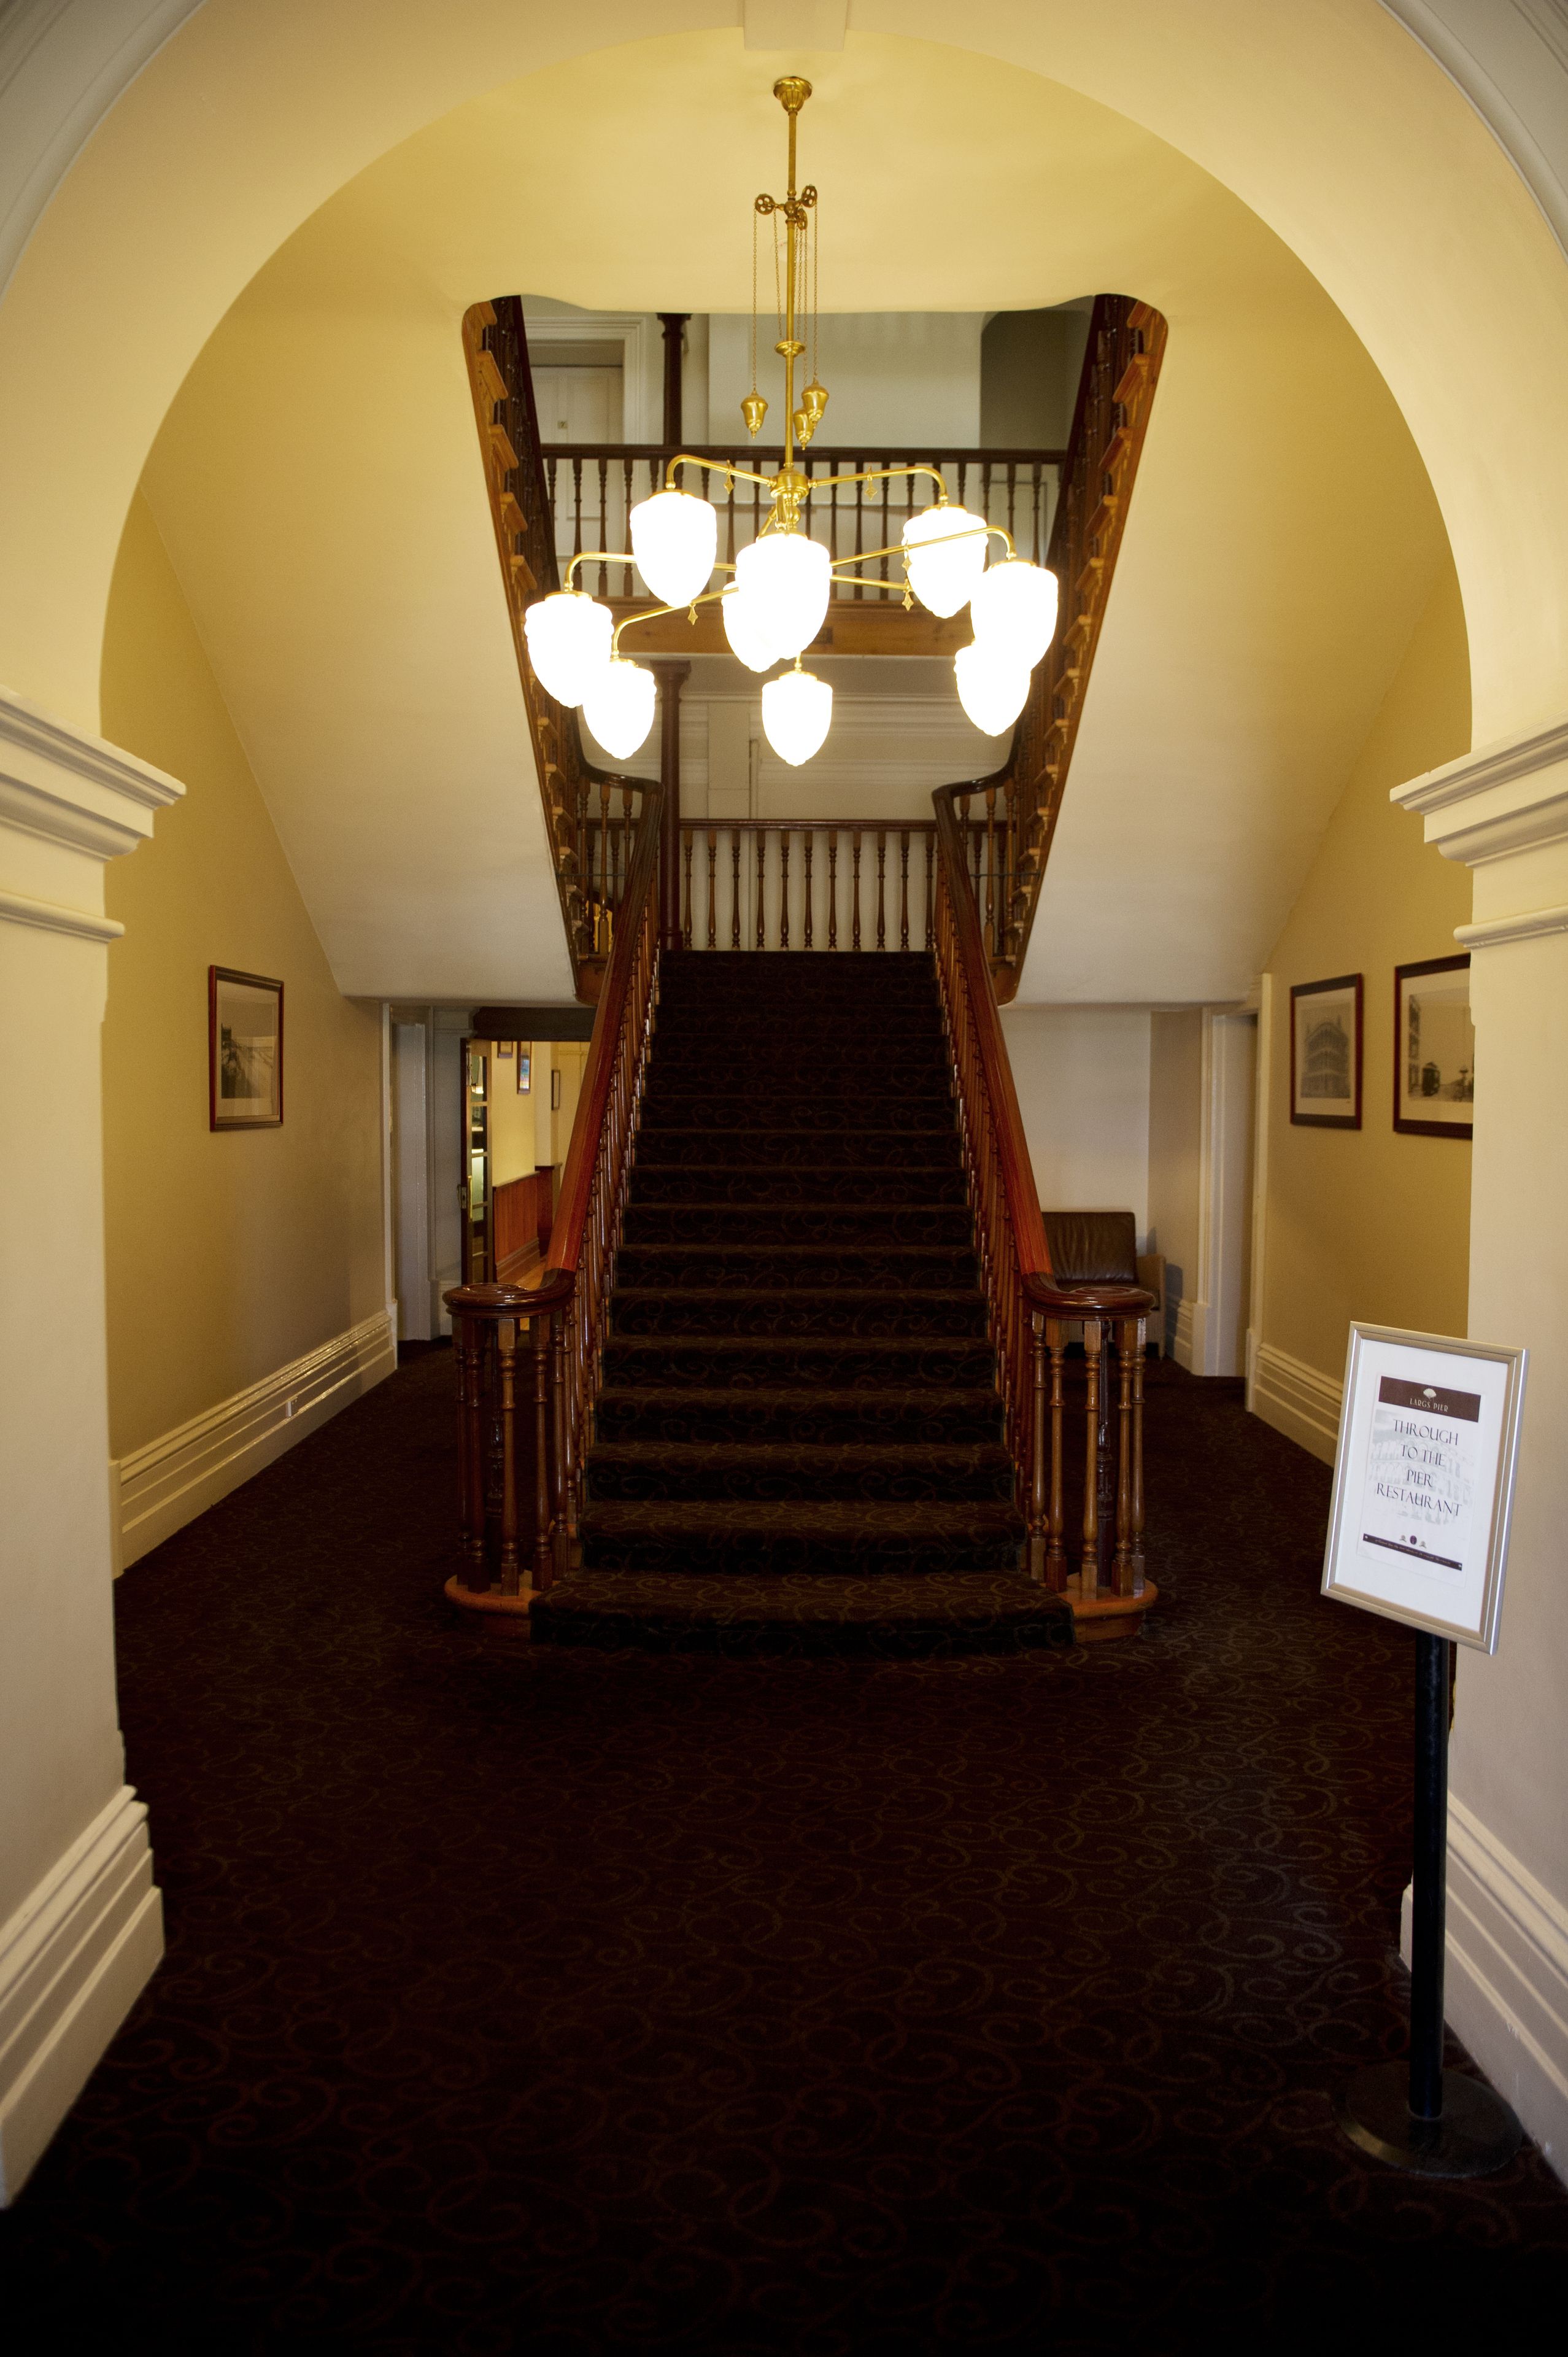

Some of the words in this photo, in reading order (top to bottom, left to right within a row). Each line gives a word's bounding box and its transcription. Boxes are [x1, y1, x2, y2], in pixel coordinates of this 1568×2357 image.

[1410, 1398, 1431, 1408] LARGS
[1433, 1403, 1448, 1412] PIER
[1394, 1418, 1458, 1446] THROUGH
[1401, 1444, 1418, 1459] TO
[1423, 1449, 1446, 1466] THE
[1407, 1469, 1433, 1488] PIER
[1377, 1482, 1462, 1516] RESTAURANT
